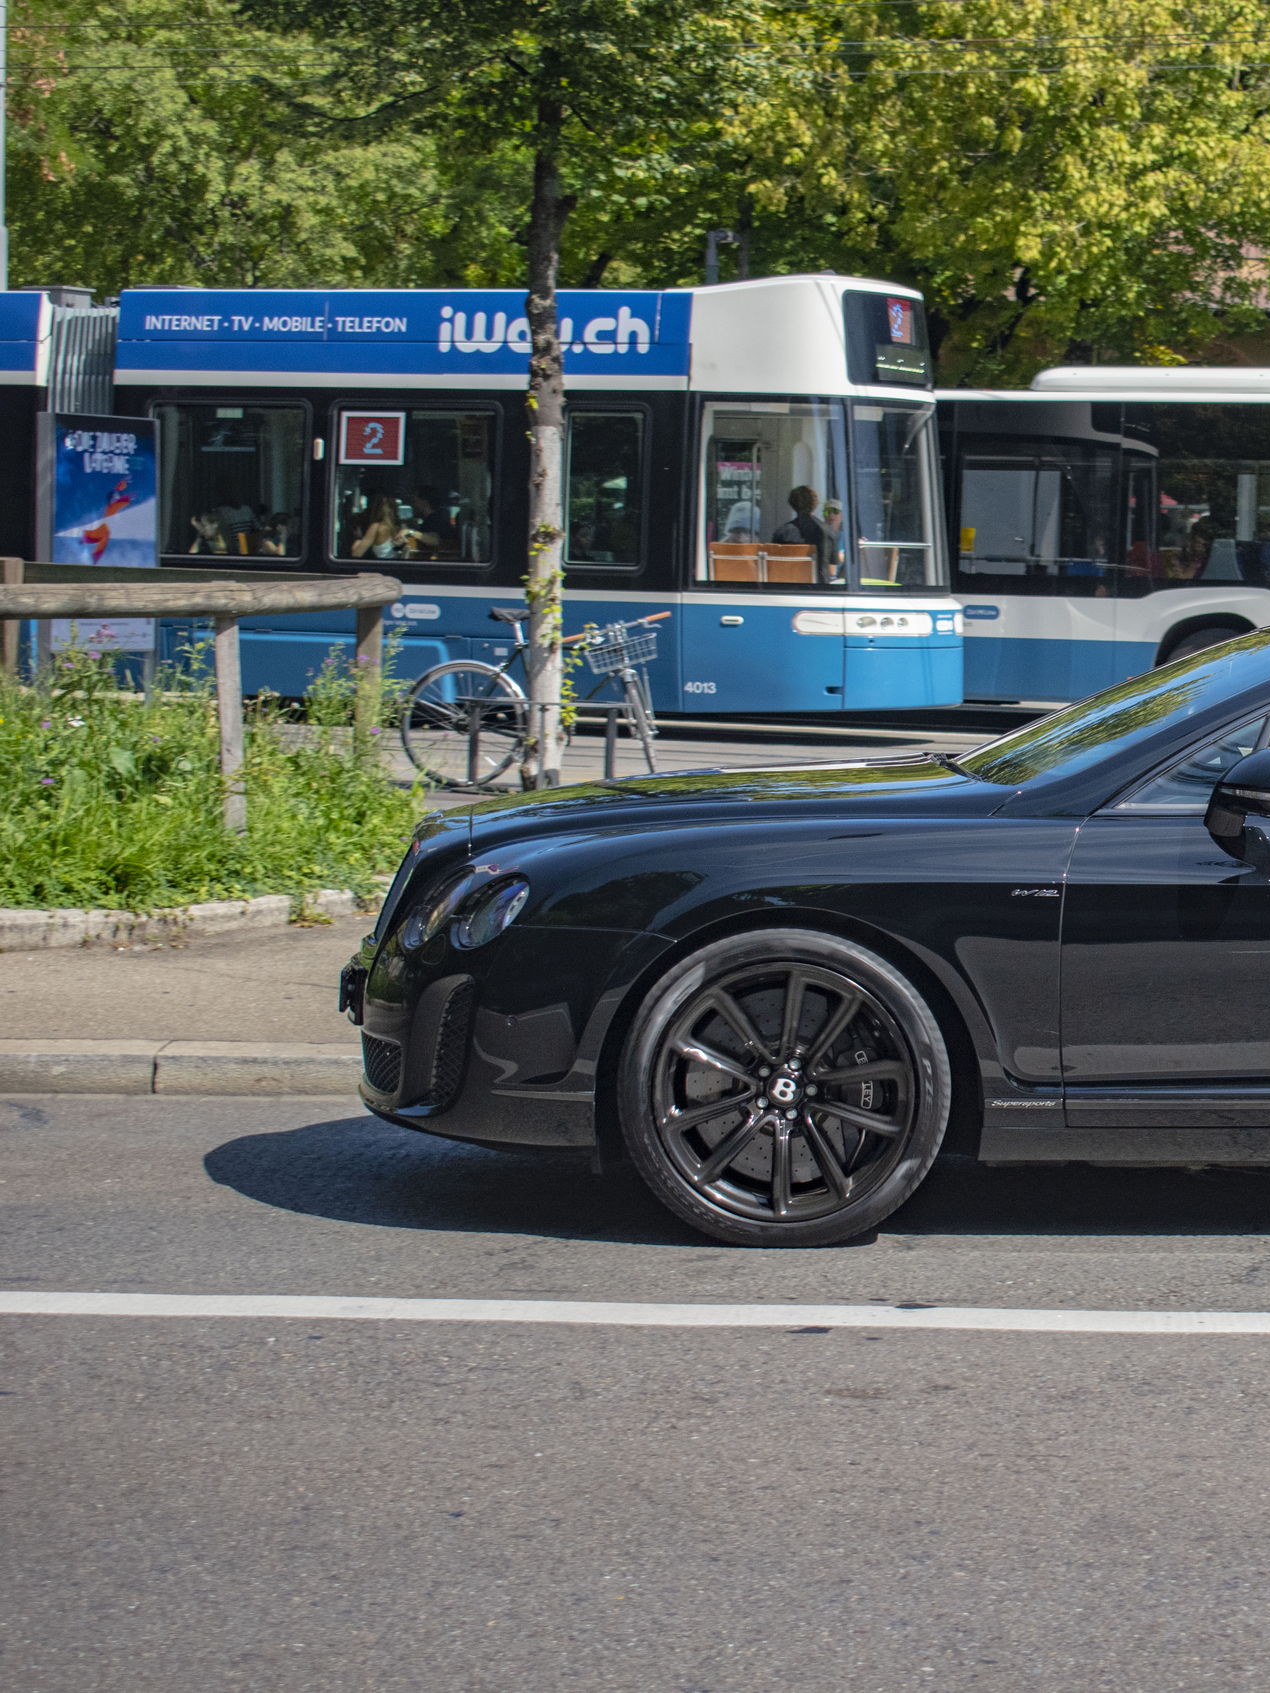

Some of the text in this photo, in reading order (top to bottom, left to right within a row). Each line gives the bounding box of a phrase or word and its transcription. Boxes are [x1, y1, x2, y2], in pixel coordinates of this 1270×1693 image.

[144, 315, 408, 333] INTERNET TV MOBILE TELEFON
[891, 304, 904, 338] 2
[363, 421, 385, 455] 2
[684, 681, 717, 694] 4013
[772, 1078, 797, 1102] B
[991, 1099, 1056, 1108] Supersports
